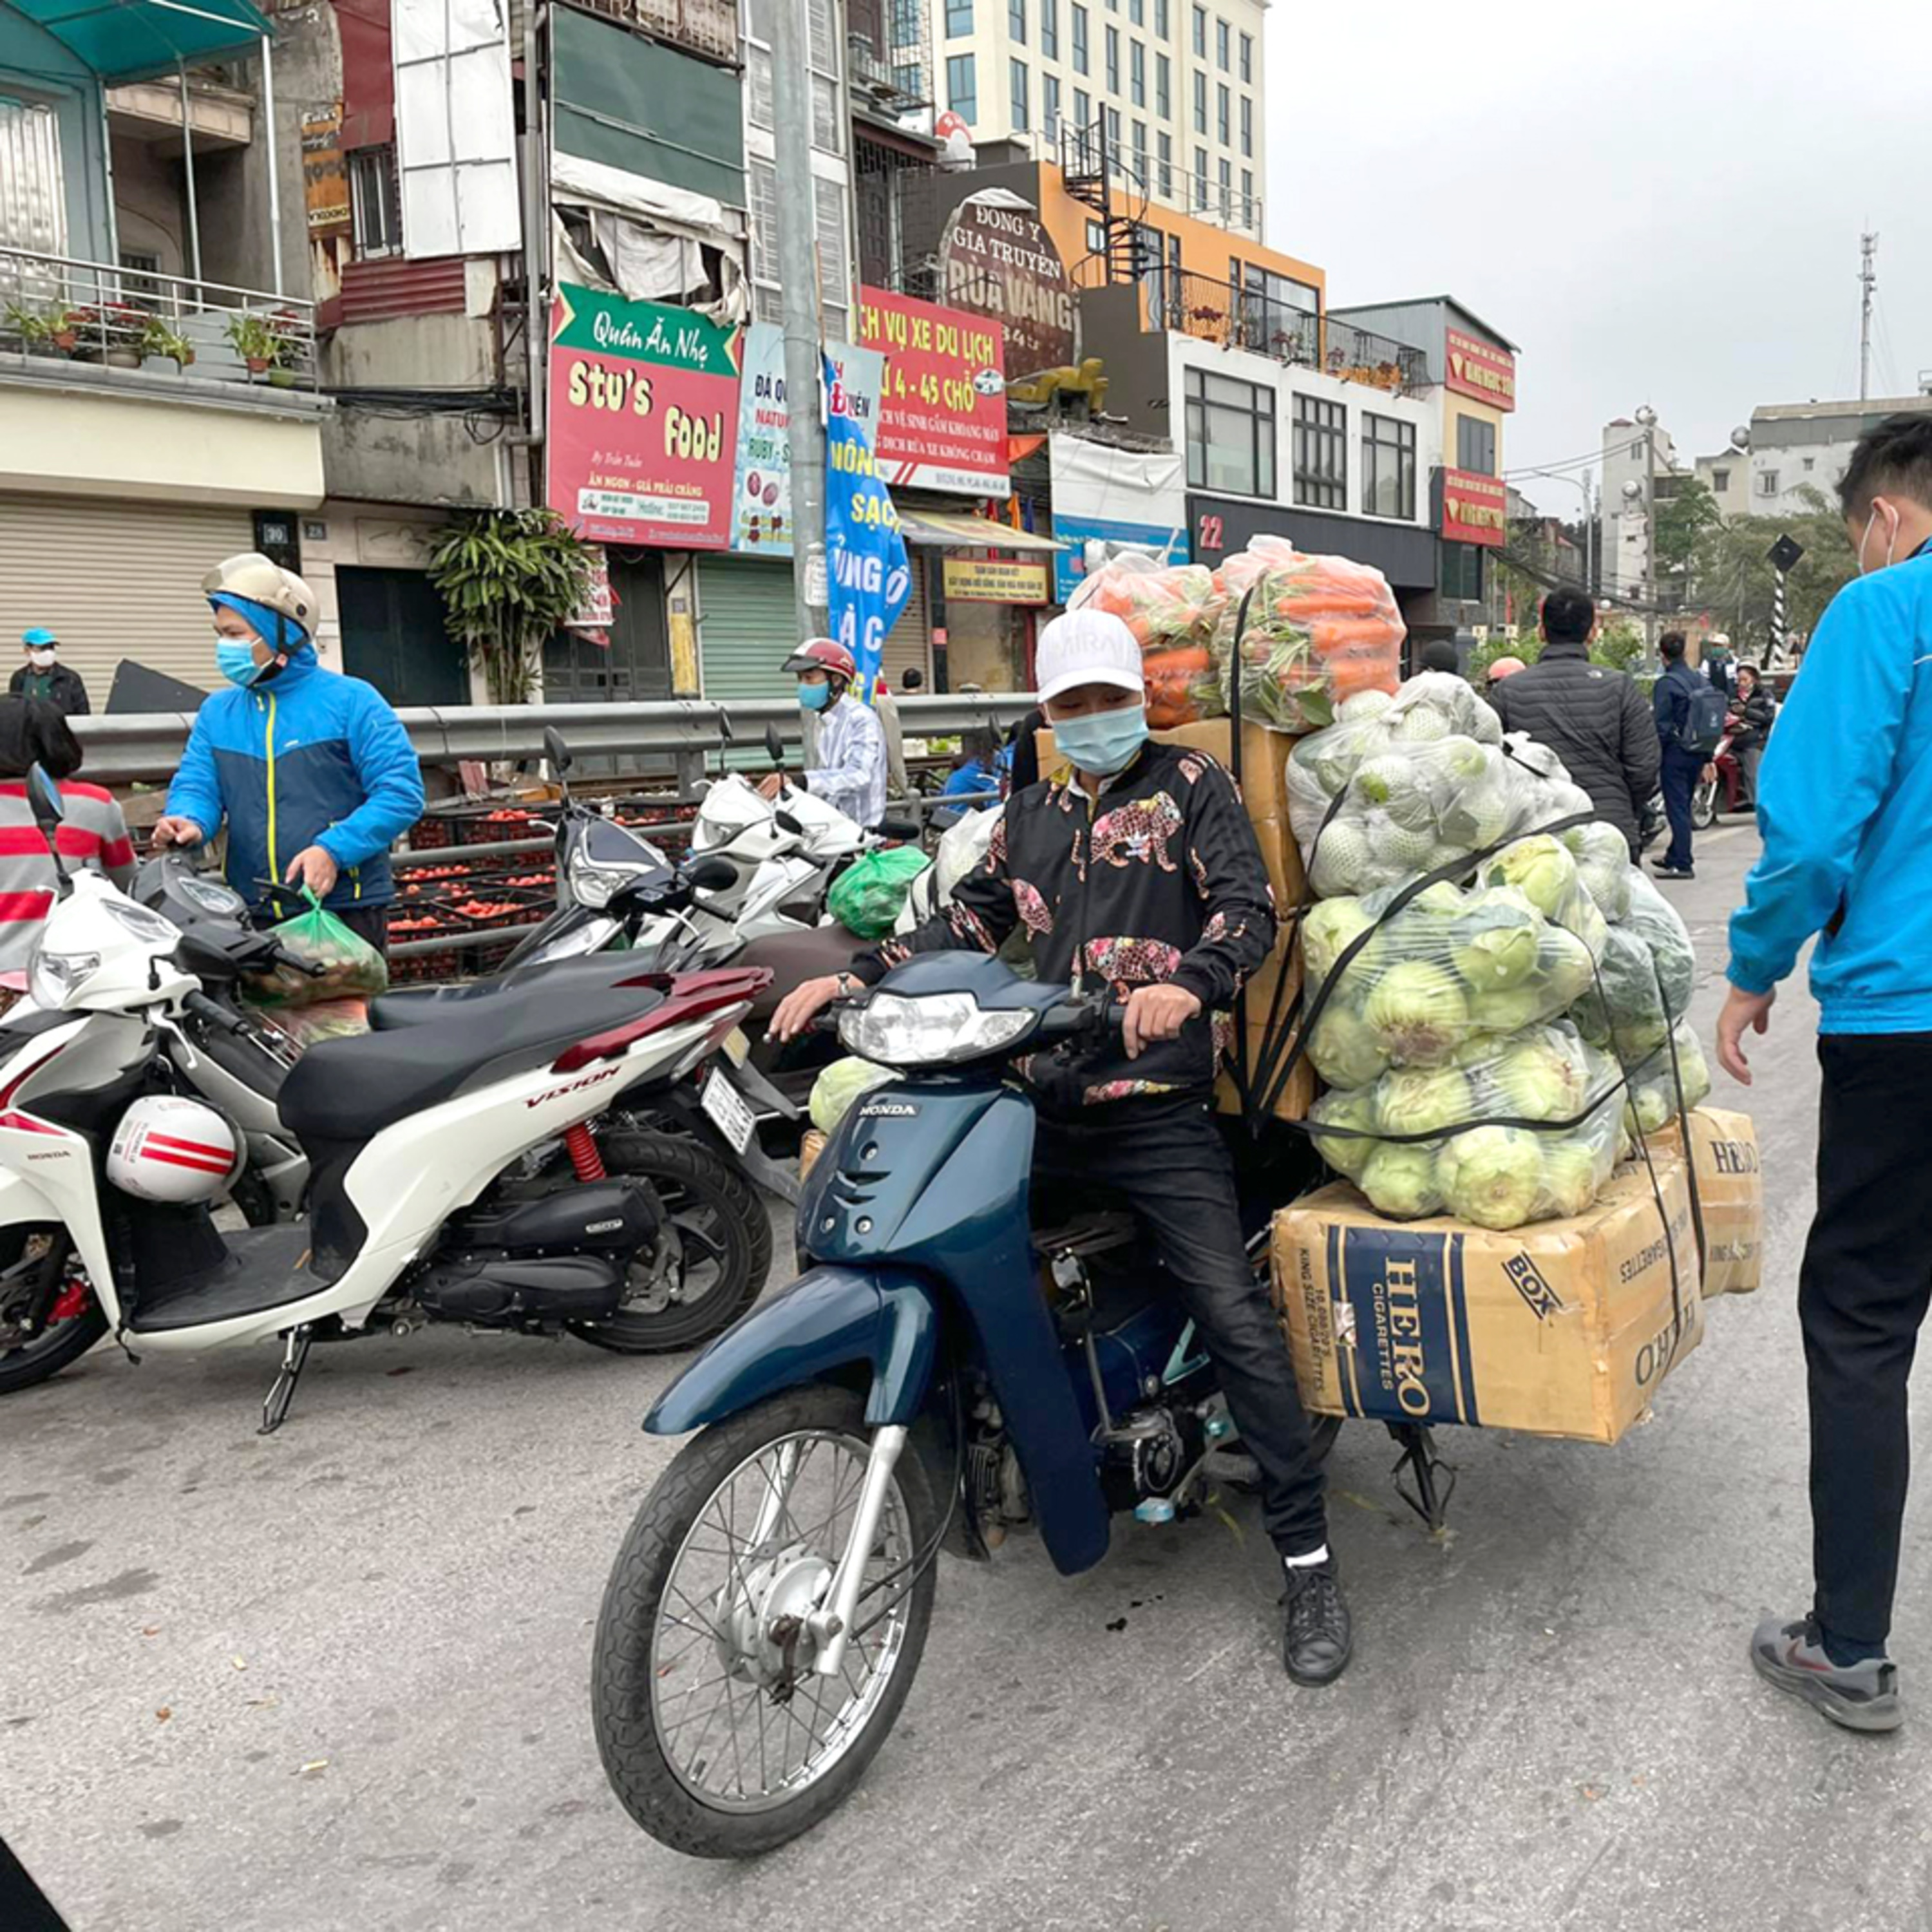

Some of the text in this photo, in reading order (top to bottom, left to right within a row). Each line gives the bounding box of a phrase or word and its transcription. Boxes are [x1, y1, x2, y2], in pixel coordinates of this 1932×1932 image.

[952, 225, 987, 255] GIA
[1005, 271, 1074, 332] VÀNG
[592, 310, 709, 370] Quán Ăn Nhẹ
[884, 310, 907, 352] VỤ
[911, 317, 931, 352] XE
[936, 324, 958, 357] DU
[962, 329, 994, 368] LỊCH
[568, 359, 653, 417] Stu's
[754, 372, 772, 401] ĐÁ
[895, 368, 906, 400] 4
[920, 373, 940, 405] 45
[943, 370, 975, 413] CHỖ
[1200, 514, 1223, 551] 22
[525, 1065, 620, 1108] VISION
[859, 1104, 916, 1115] HONDA
[27, 1150, 71, 1160] HONDA
[1300, 1247, 1312, 1281] KING
[1507, 1255, 1556, 1315] BOX
[1303, 1283, 1314, 1310] SIZE
[1371, 1282, 1394, 1390] CIGARETTES
[1386, 1256, 1431, 1416] HERO
